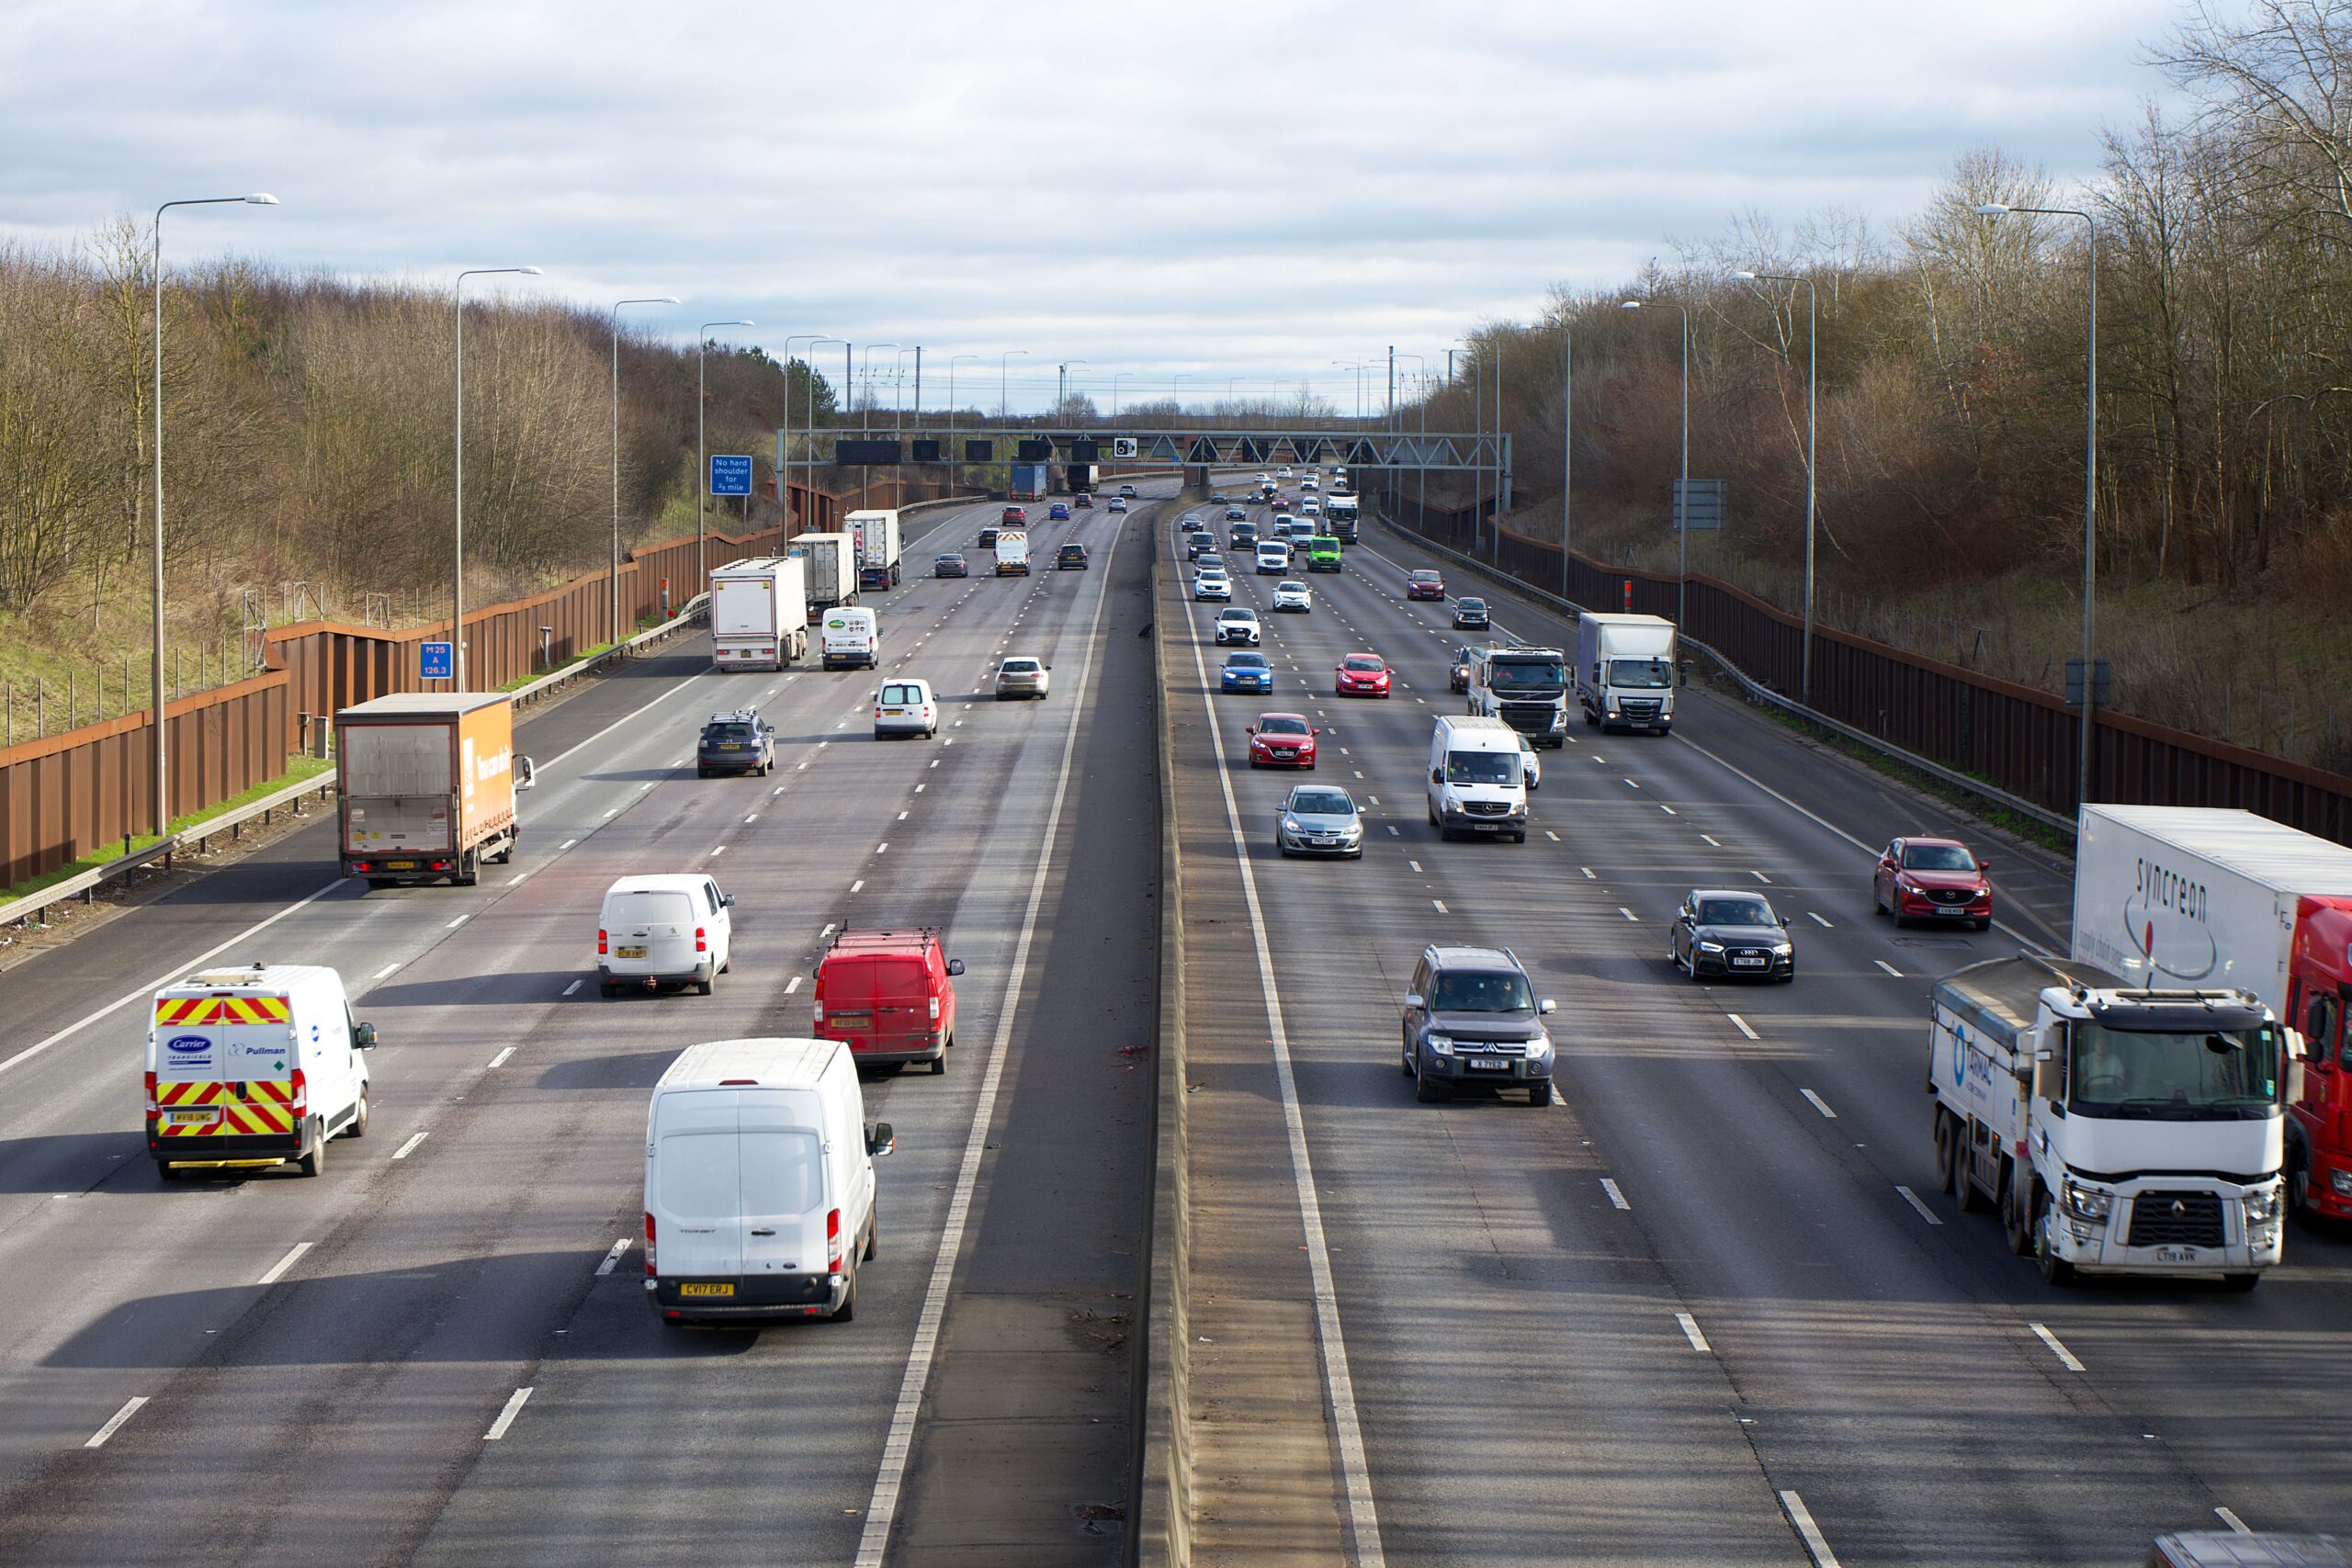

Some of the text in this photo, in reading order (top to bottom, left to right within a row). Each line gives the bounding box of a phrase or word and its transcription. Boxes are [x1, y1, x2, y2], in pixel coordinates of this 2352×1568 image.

[716, 458, 728, 467] No
[727, 483, 743, 491] mile
[432, 656, 439, 664] A
[424, 666, 447, 674] 126.3
[2136, 857, 2206, 924] syncreon
[173, 1039, 207, 1048] Carrier
[686, 1284, 729, 1294] CV17 ERJ
